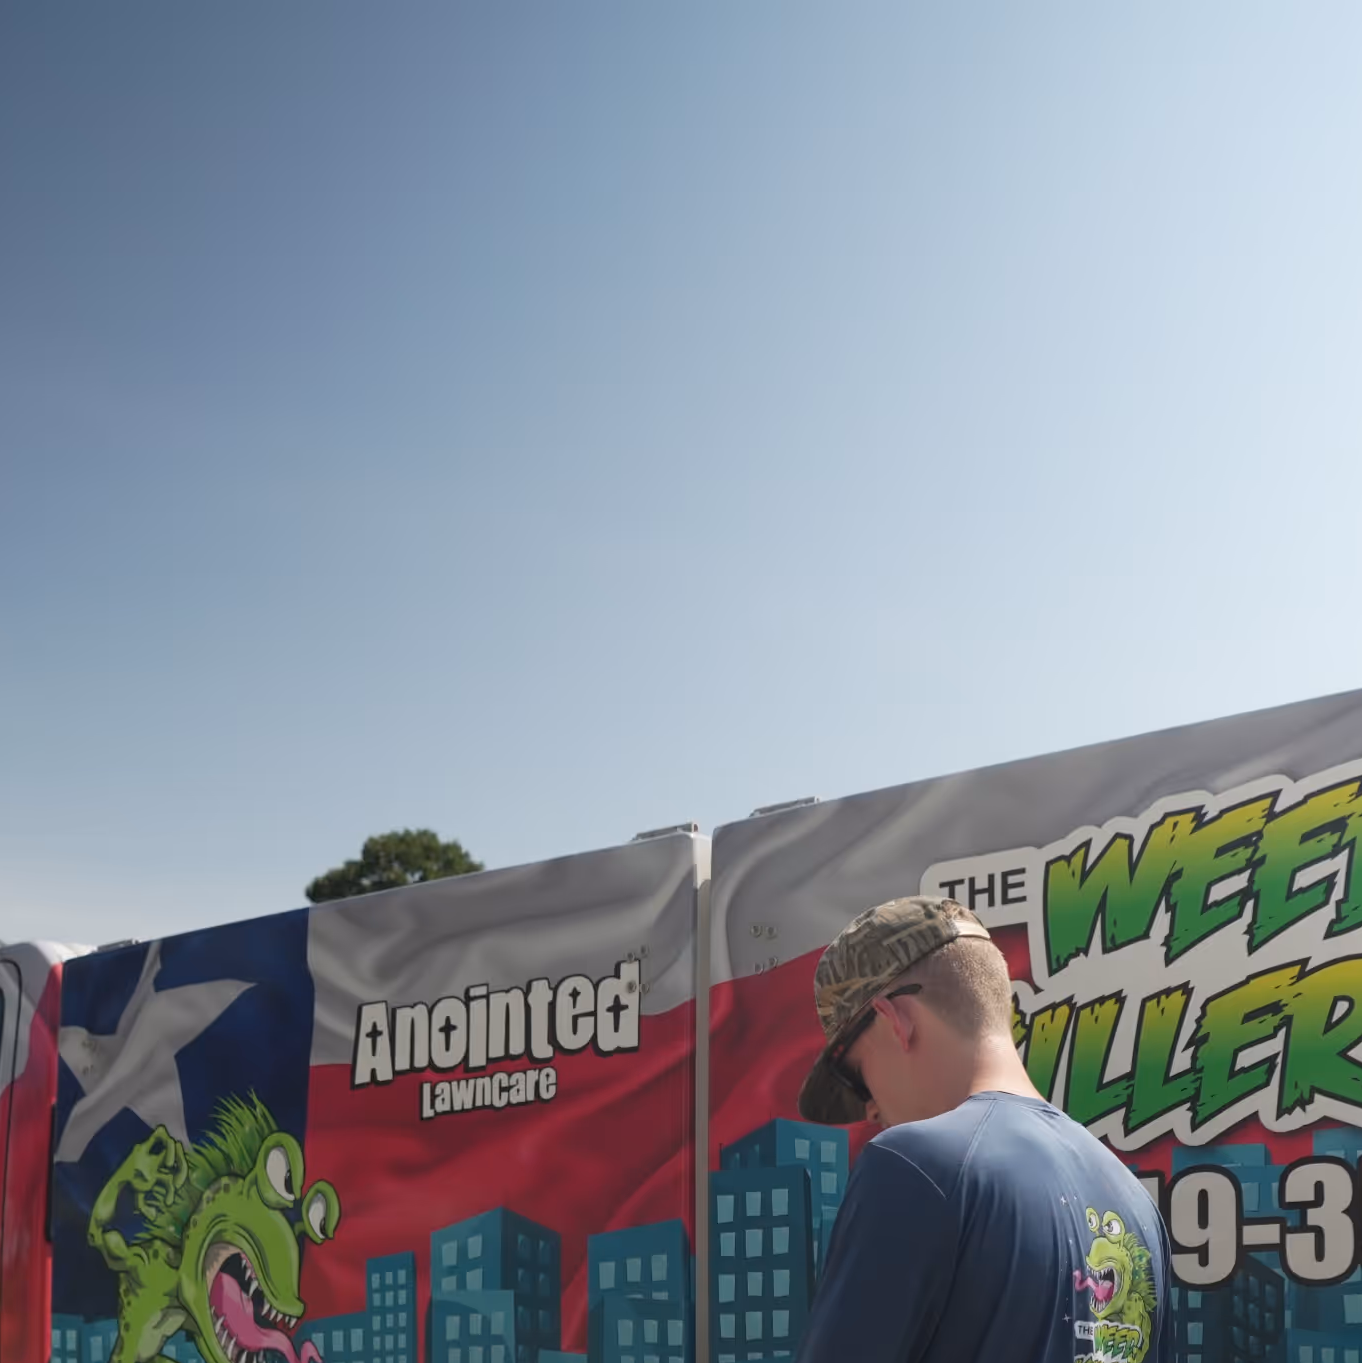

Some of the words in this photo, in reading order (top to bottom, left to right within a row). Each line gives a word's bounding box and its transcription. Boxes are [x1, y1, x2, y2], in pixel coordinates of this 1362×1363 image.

[939, 867, 1027, 910] THE
[350, 958, 640, 1090] Anointed
[1078, 1324, 1094, 1336] THE
